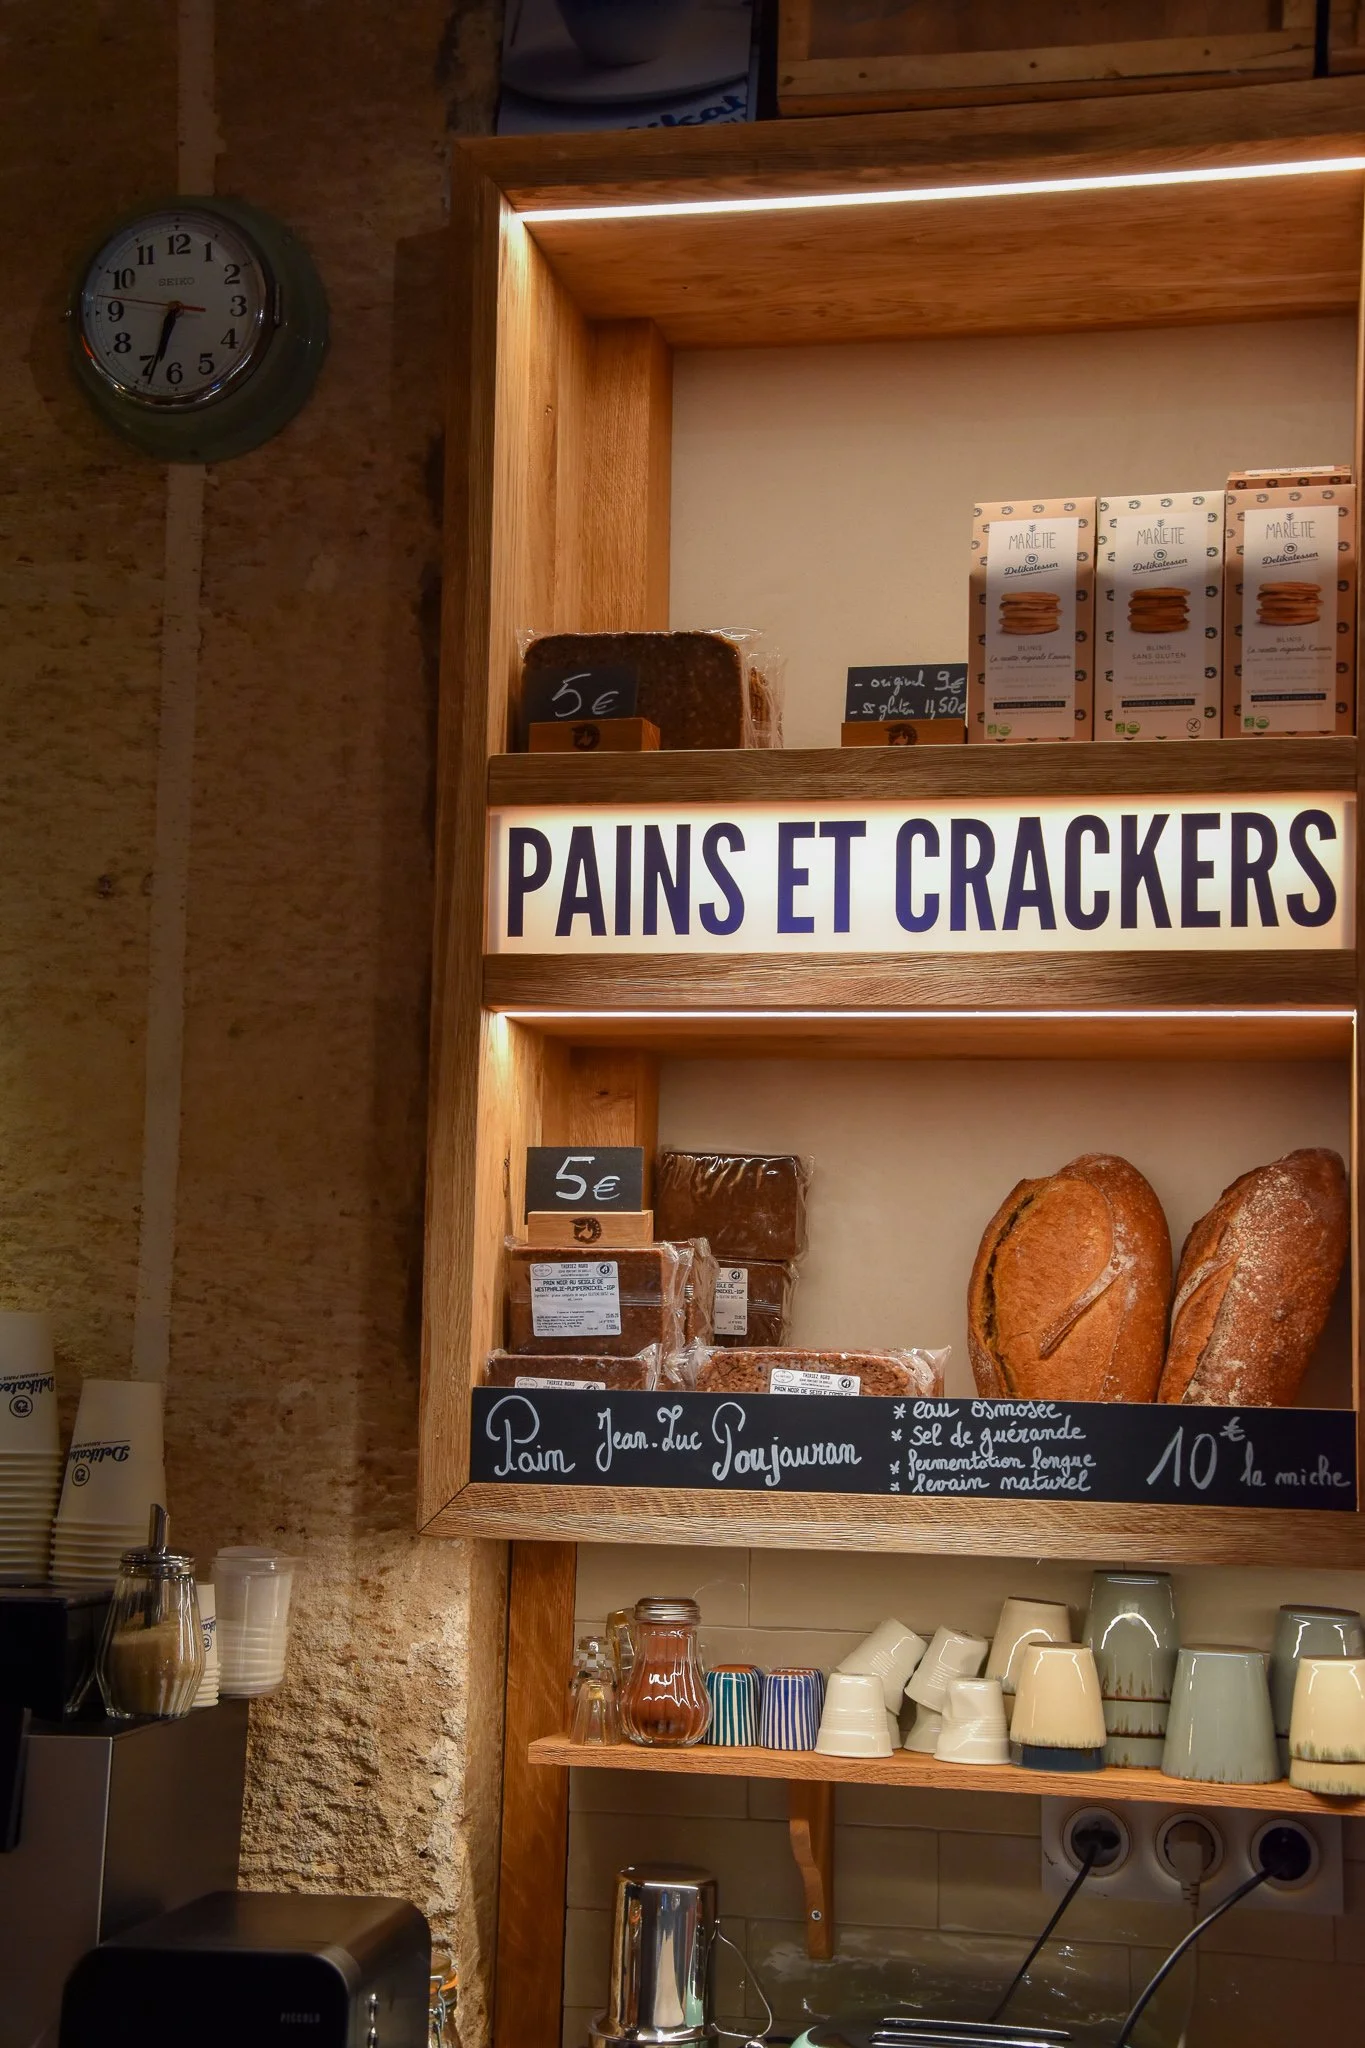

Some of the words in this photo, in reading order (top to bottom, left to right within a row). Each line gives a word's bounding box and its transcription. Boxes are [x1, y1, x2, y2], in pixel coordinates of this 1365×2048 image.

[137, 245, 155, 266] 11
[167, 234, 191, 255] 12
[204, 242, 214, 262] 1
[113, 268, 135, 290] 10
[158, 277, 195, 287] SEIKO
[224, 264, 241, 285] 2
[107, 300, 125, 322] 9
[230, 295, 247, 317] 3
[113, 332, 132, 353] 8
[220, 328, 240, 349] 4
[139, 355, 155, 377] 7
[166, 362, 183, 384] 6
[198, 353, 215, 375] 5
[1004, 562, 1058, 576] Delikatessen
[1132, 558, 1188, 572] Delikatessen
[1261, 551, 1319, 566] Delikatessen
[507, 821, 746, 937] PAINS
[777, 820, 867, 934] ET
[895, 809, 1337, 933] CRACKERS
[554, 1155, 621, 1201] 5€
[911, 1400, 960, 1419] eau
[485, 1394, 576, 1477] Pain
[711, 1401, 862, 1487] Poujauran
[949, 1421, 974, 1447] de
[980, 1420, 1087, 1458] guérande
[907, 1448, 1027, 1478] fermentation
[1030, 1448, 1097, 1478] longue
[1239, 1440, 1267, 1488] la
[1274, 1453, 1352, 1487] miche
[912, 1470, 991, 1494] levain
[1000, 1470, 1092, 1493] naturel
[280, 2011, 321, 2024] PICCOLO
